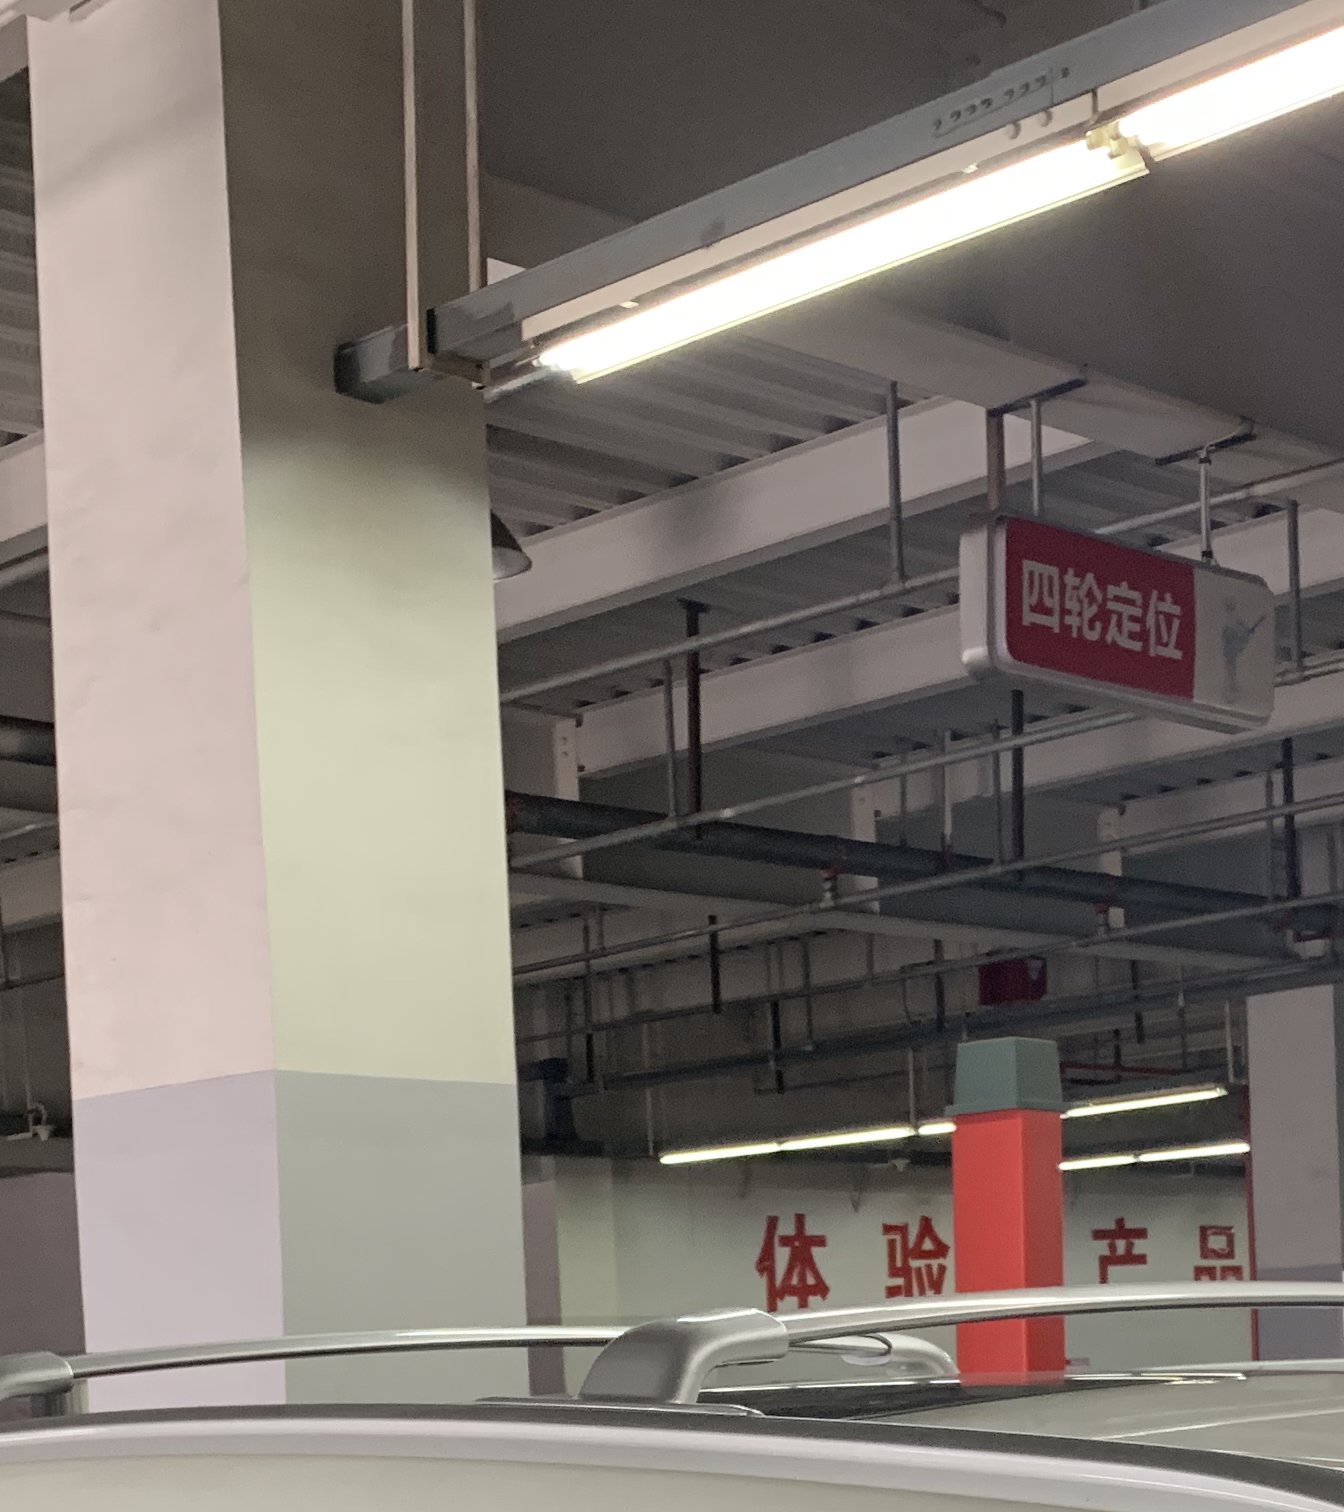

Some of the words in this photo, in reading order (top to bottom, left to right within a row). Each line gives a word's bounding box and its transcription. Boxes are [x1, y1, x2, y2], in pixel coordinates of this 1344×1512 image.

[1022, 560, 1183, 660] 四轮定位
[756, 1213, 951, 1313] 体验
[1091, 1217, 1244, 1283] 产品
